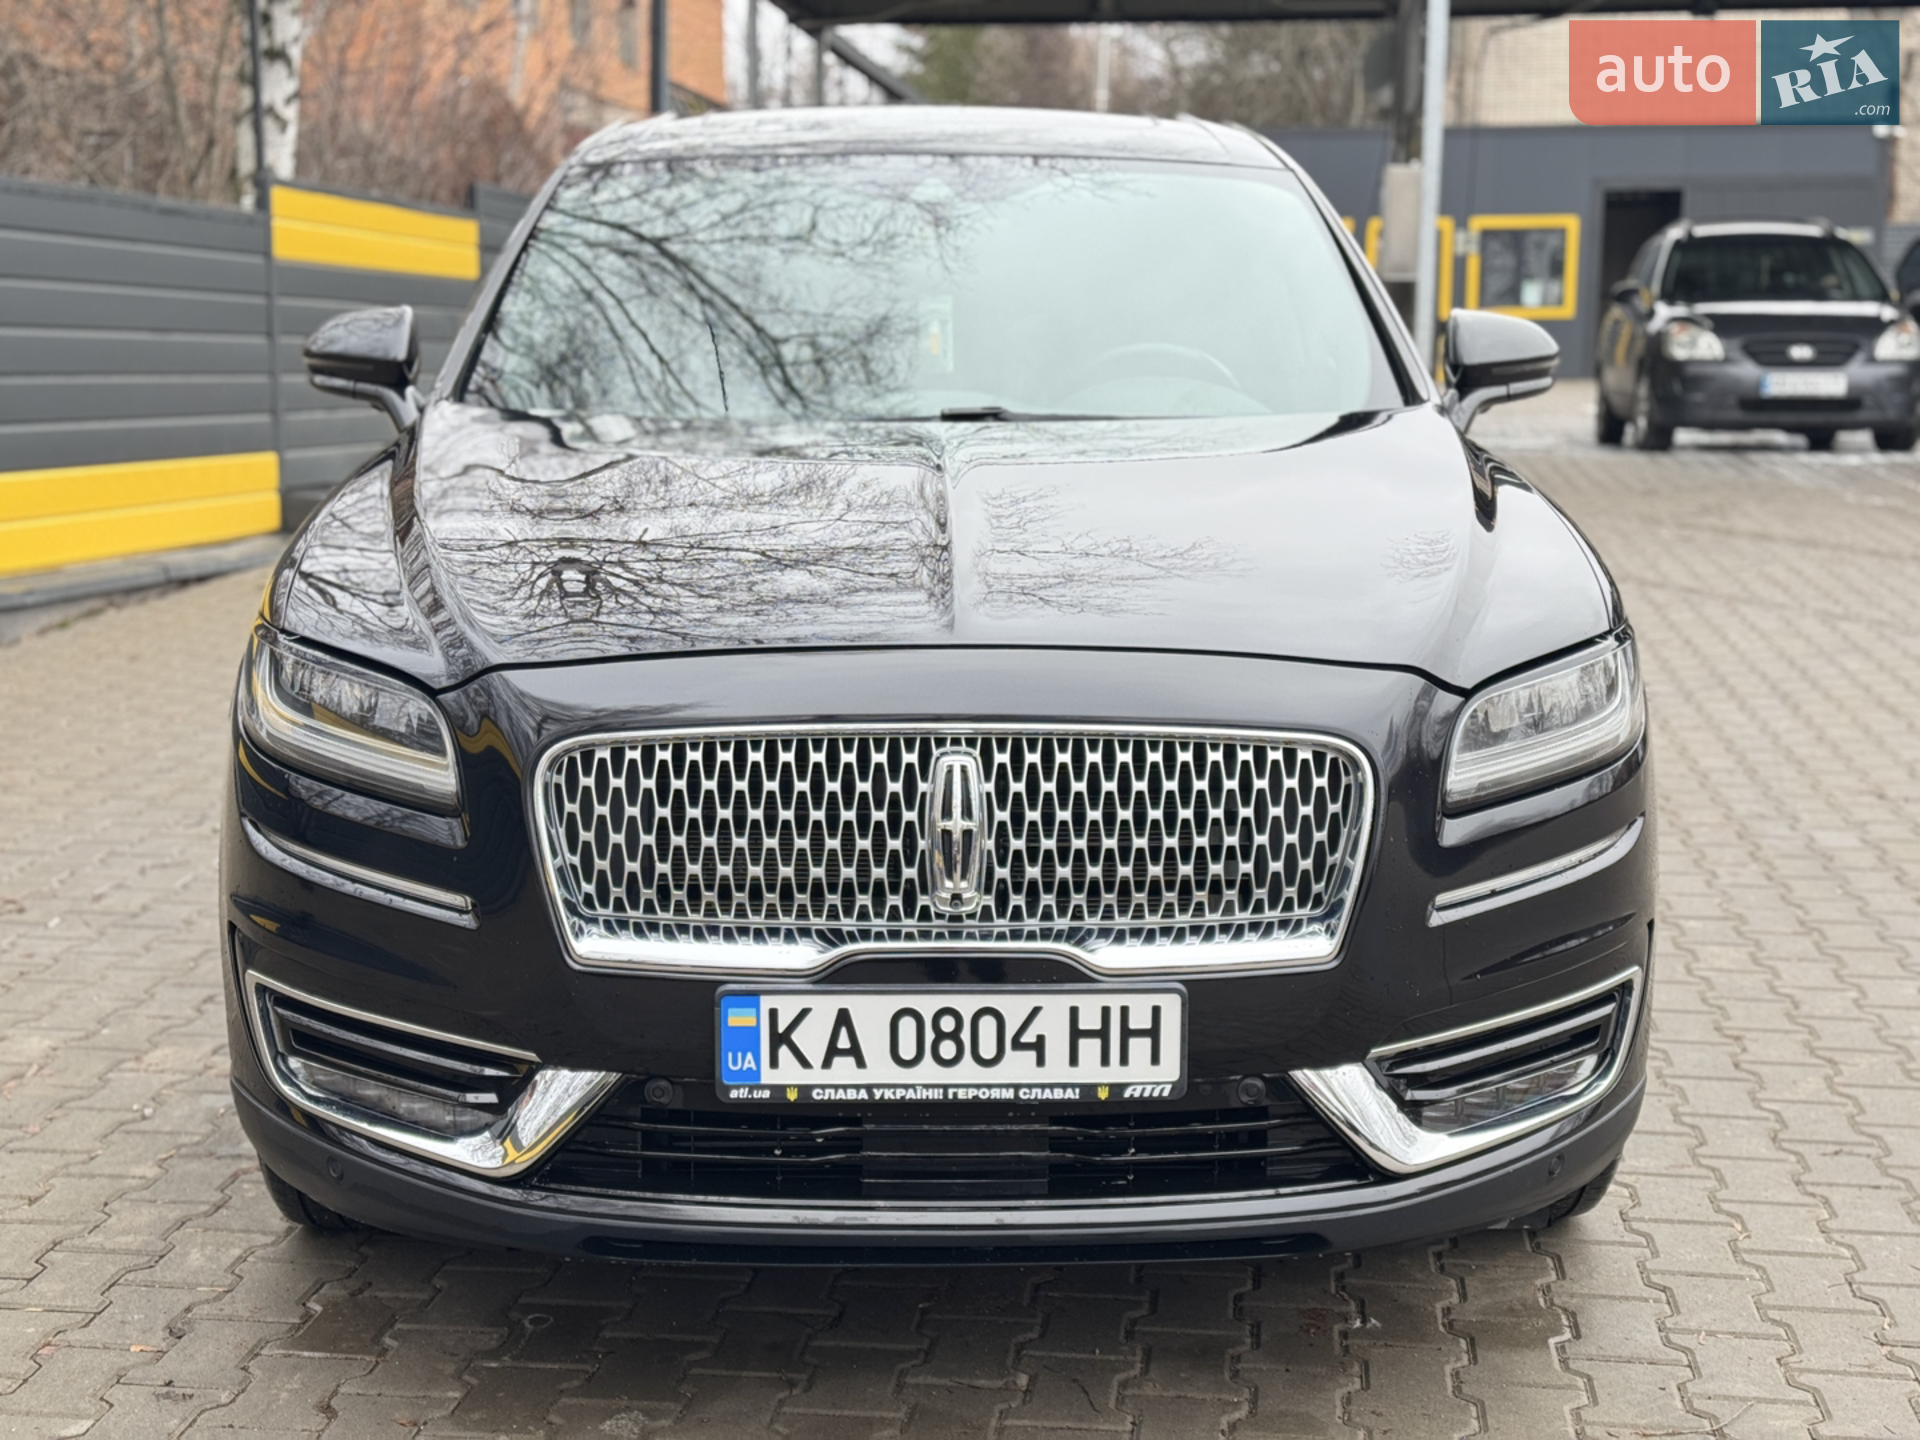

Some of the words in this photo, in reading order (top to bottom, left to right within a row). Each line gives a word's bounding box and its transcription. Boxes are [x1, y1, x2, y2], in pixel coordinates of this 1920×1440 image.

[768, 1007, 868, 1070] KA
[889, 1006, 1047, 1069] 0804
[1068, 1005, 1162, 1068] HH
[728, 1051, 758, 1072] UA
[729, 1087, 771, 1099] atl.ua
[812, 1088, 869, 1100] СЛАВА
[872, 1086, 944, 1100] УКРАЇНІ!
[948, 1087, 1014, 1100] ГЕРОЯМ
[1018, 1087, 1080, 1100] СЛАВА!
